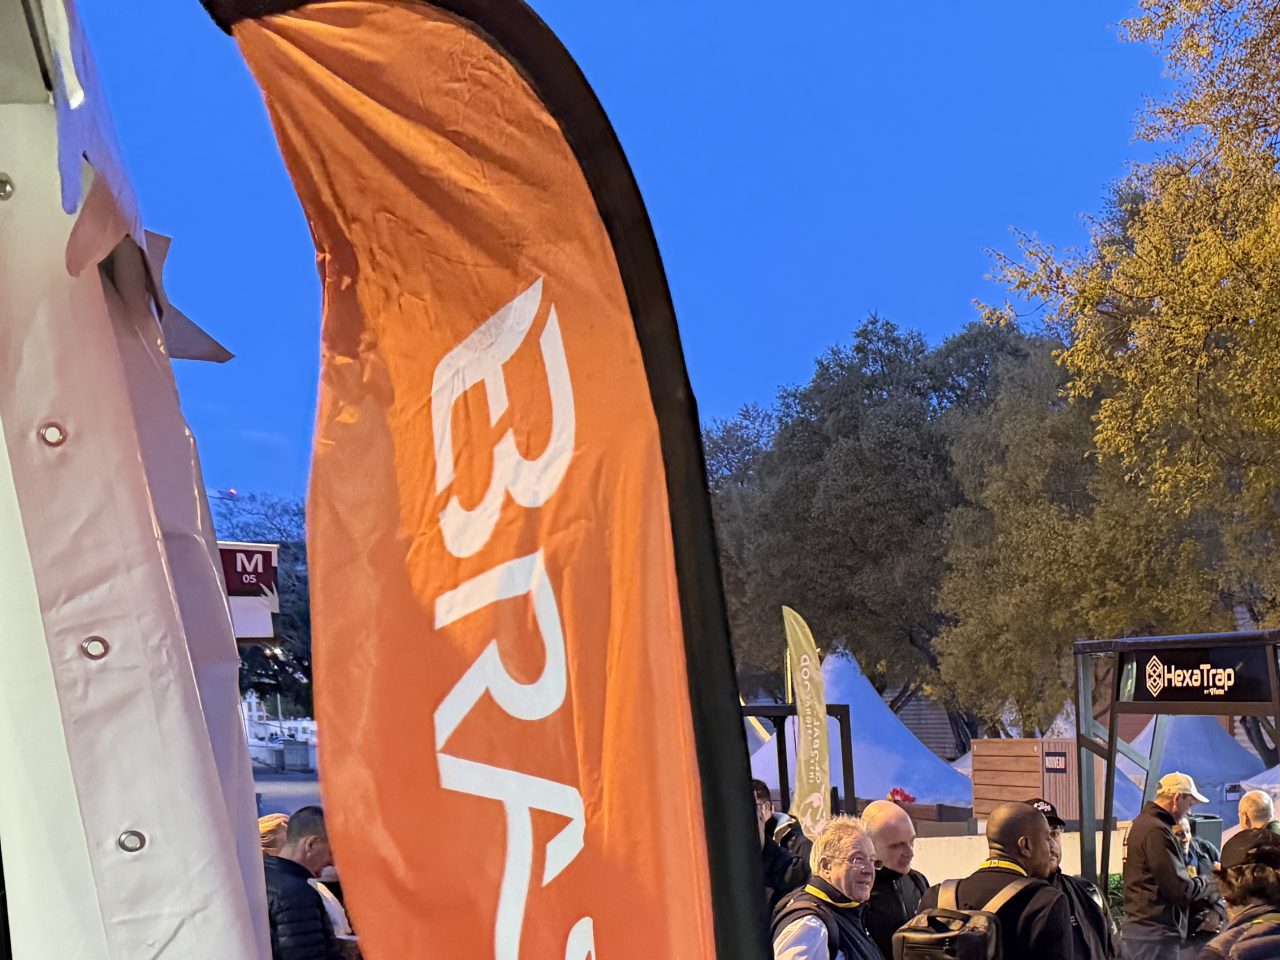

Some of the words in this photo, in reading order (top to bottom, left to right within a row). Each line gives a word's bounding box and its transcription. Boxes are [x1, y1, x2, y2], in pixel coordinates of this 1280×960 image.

[236, 552, 264, 573] M
[242, 574, 257, 583] 05
[1164, 664, 1235, 690] HexaTrap
